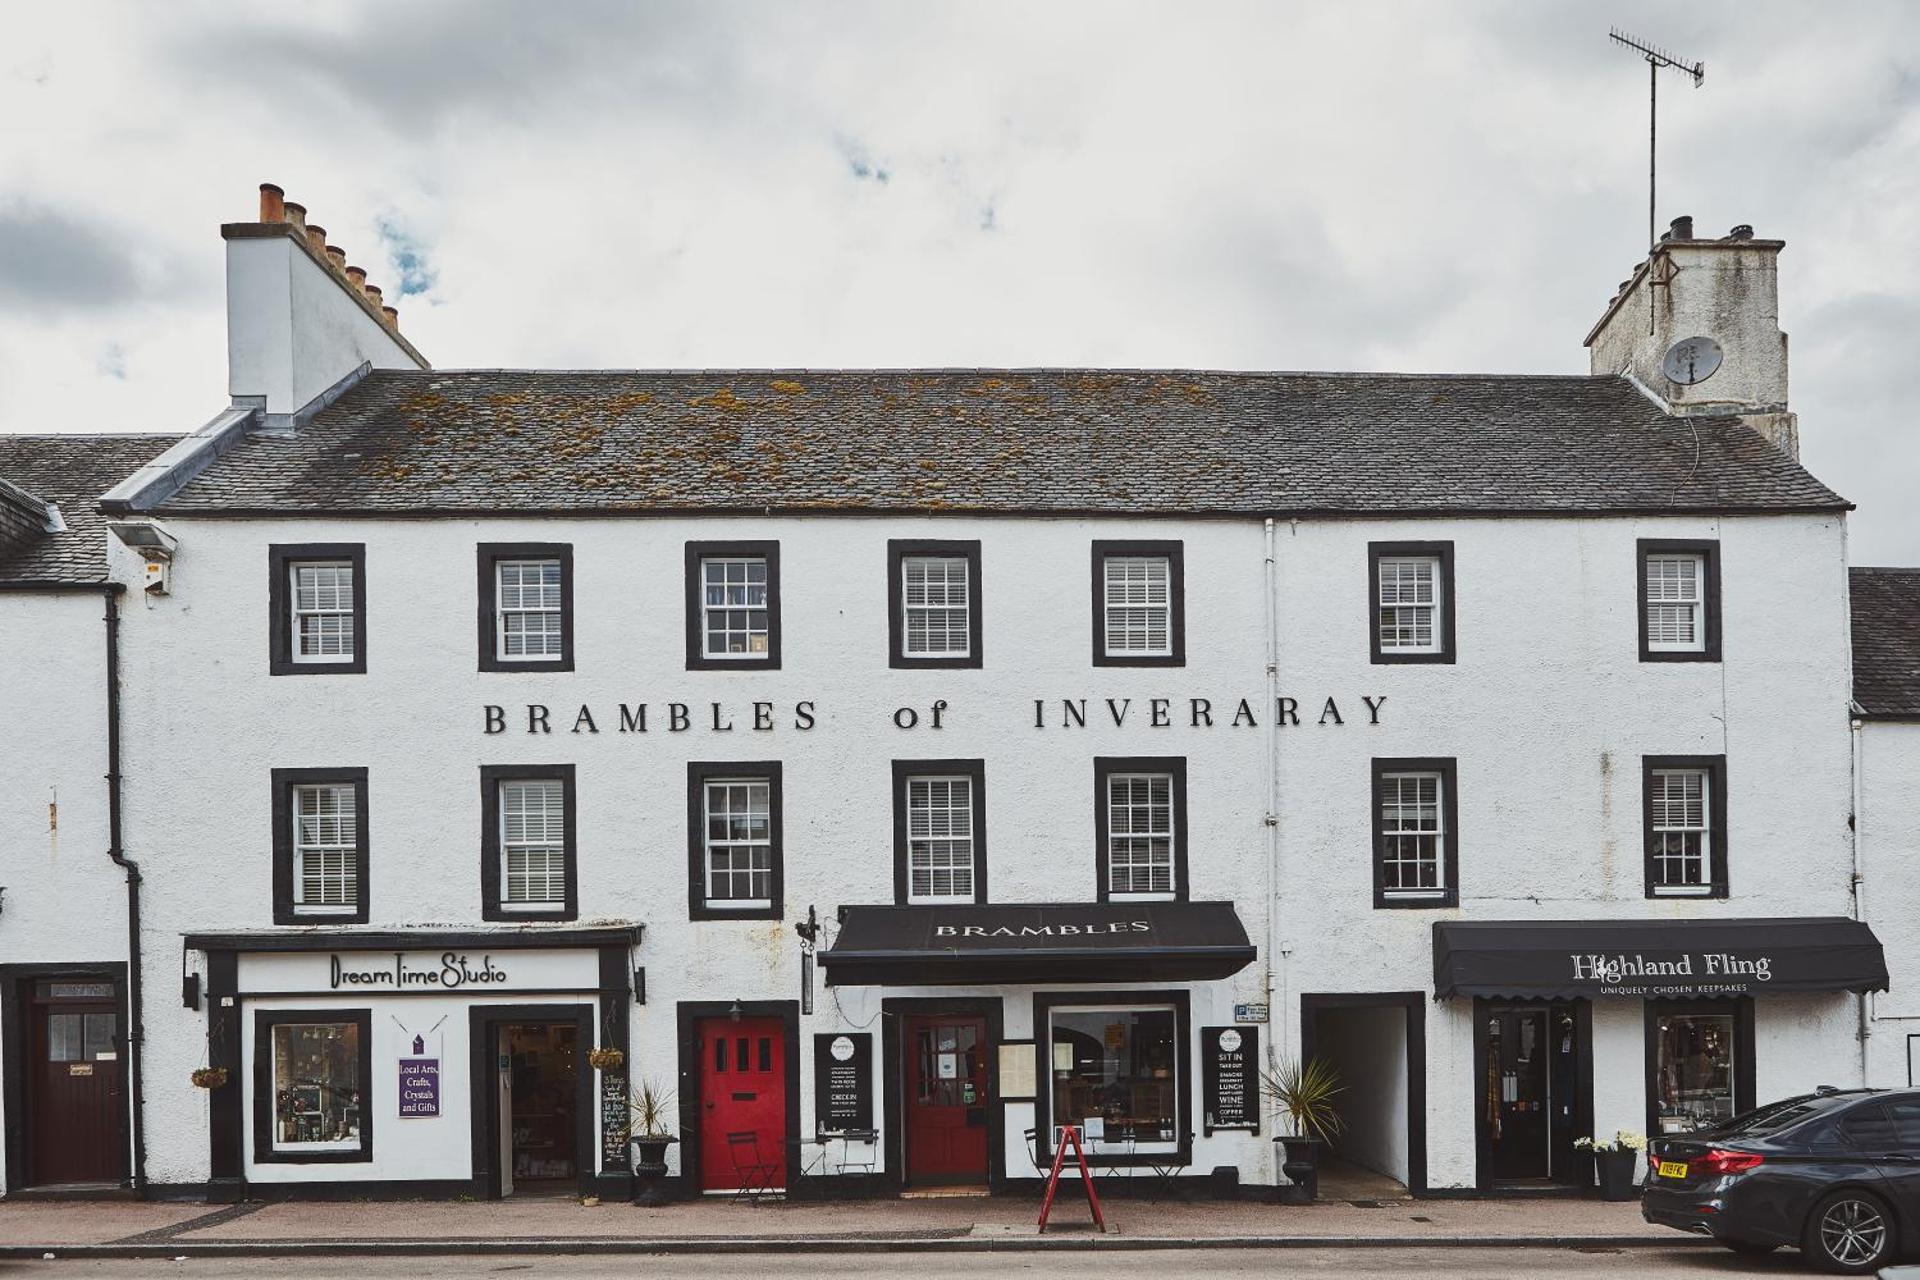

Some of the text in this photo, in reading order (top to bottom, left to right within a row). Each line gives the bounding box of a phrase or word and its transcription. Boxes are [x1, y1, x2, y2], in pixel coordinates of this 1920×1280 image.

[483, 696, 1387, 734] BRAMBLES of INVERARAY
[936, 921, 1150, 937] BRAMBLES
[1570, 953, 1771, 983] Highland Fling
[1600, 984, 1747, 995] UNIQUELY CHOSEN KEEPSAKES
[400, 1065, 420, 1075] Local
[404, 1090, 434, 1101] Crystals
[1219, 1096, 1243, 1104] WINE
[402, 1103, 436, 1112] and Gifts
